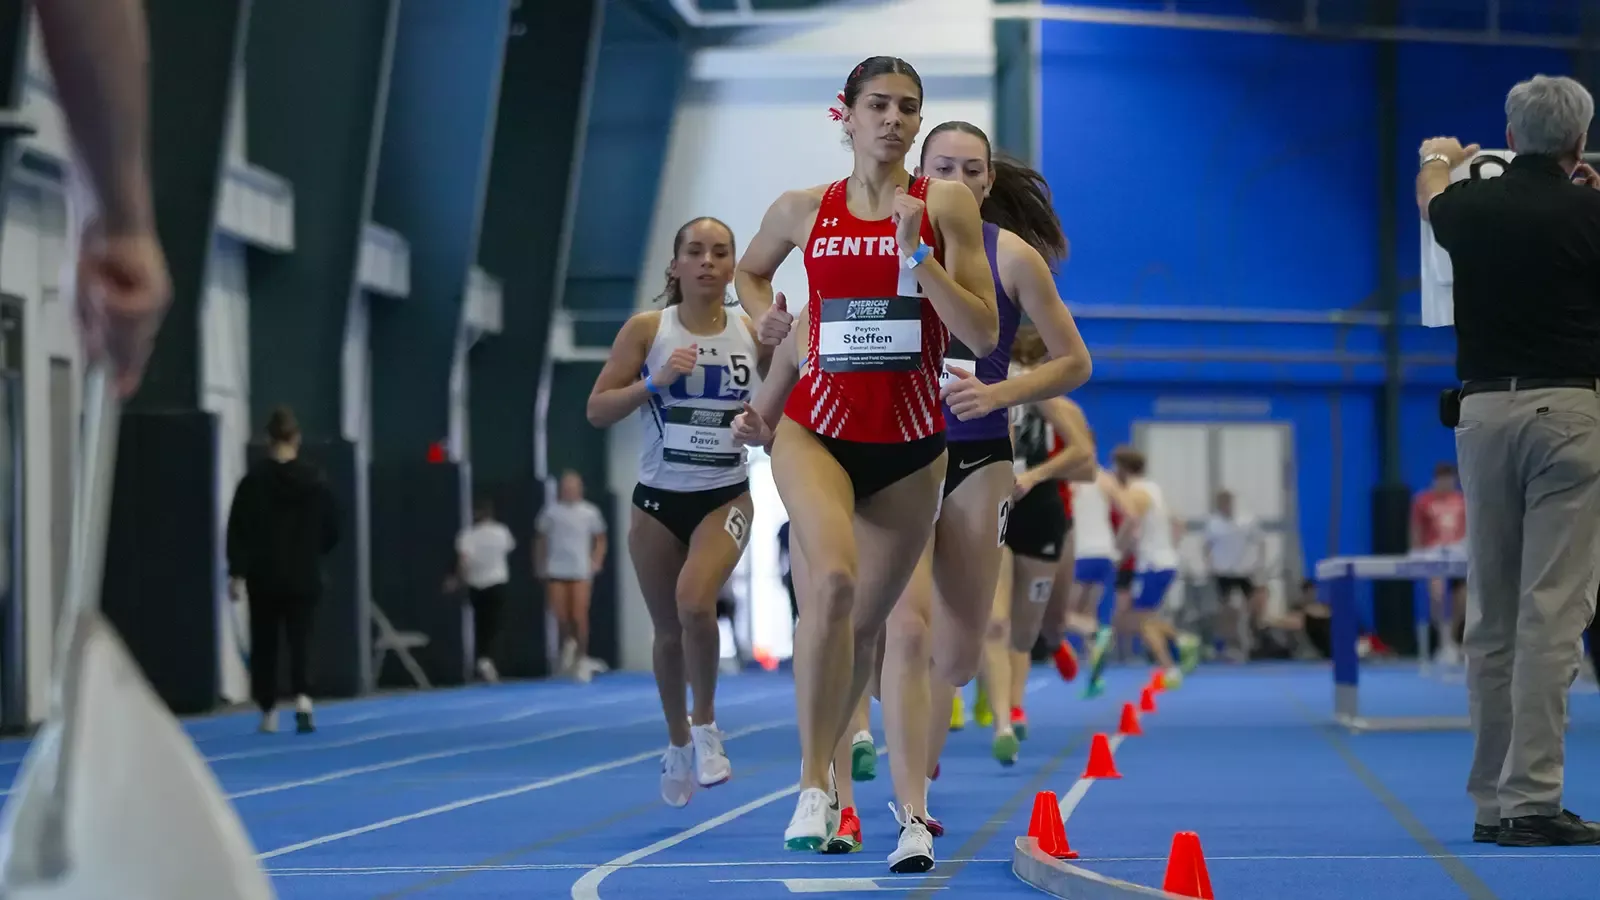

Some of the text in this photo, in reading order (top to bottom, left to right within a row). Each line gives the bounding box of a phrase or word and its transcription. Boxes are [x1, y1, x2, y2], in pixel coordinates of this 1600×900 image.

[812, 236, 899, 258] CENTR
[848, 299, 890, 308] AMERICAN
[843, 333, 893, 344] Steffen
[730, 355, 750, 386] 5
[690, 435, 720, 446] Davis
[729, 508, 747, 541] 5
